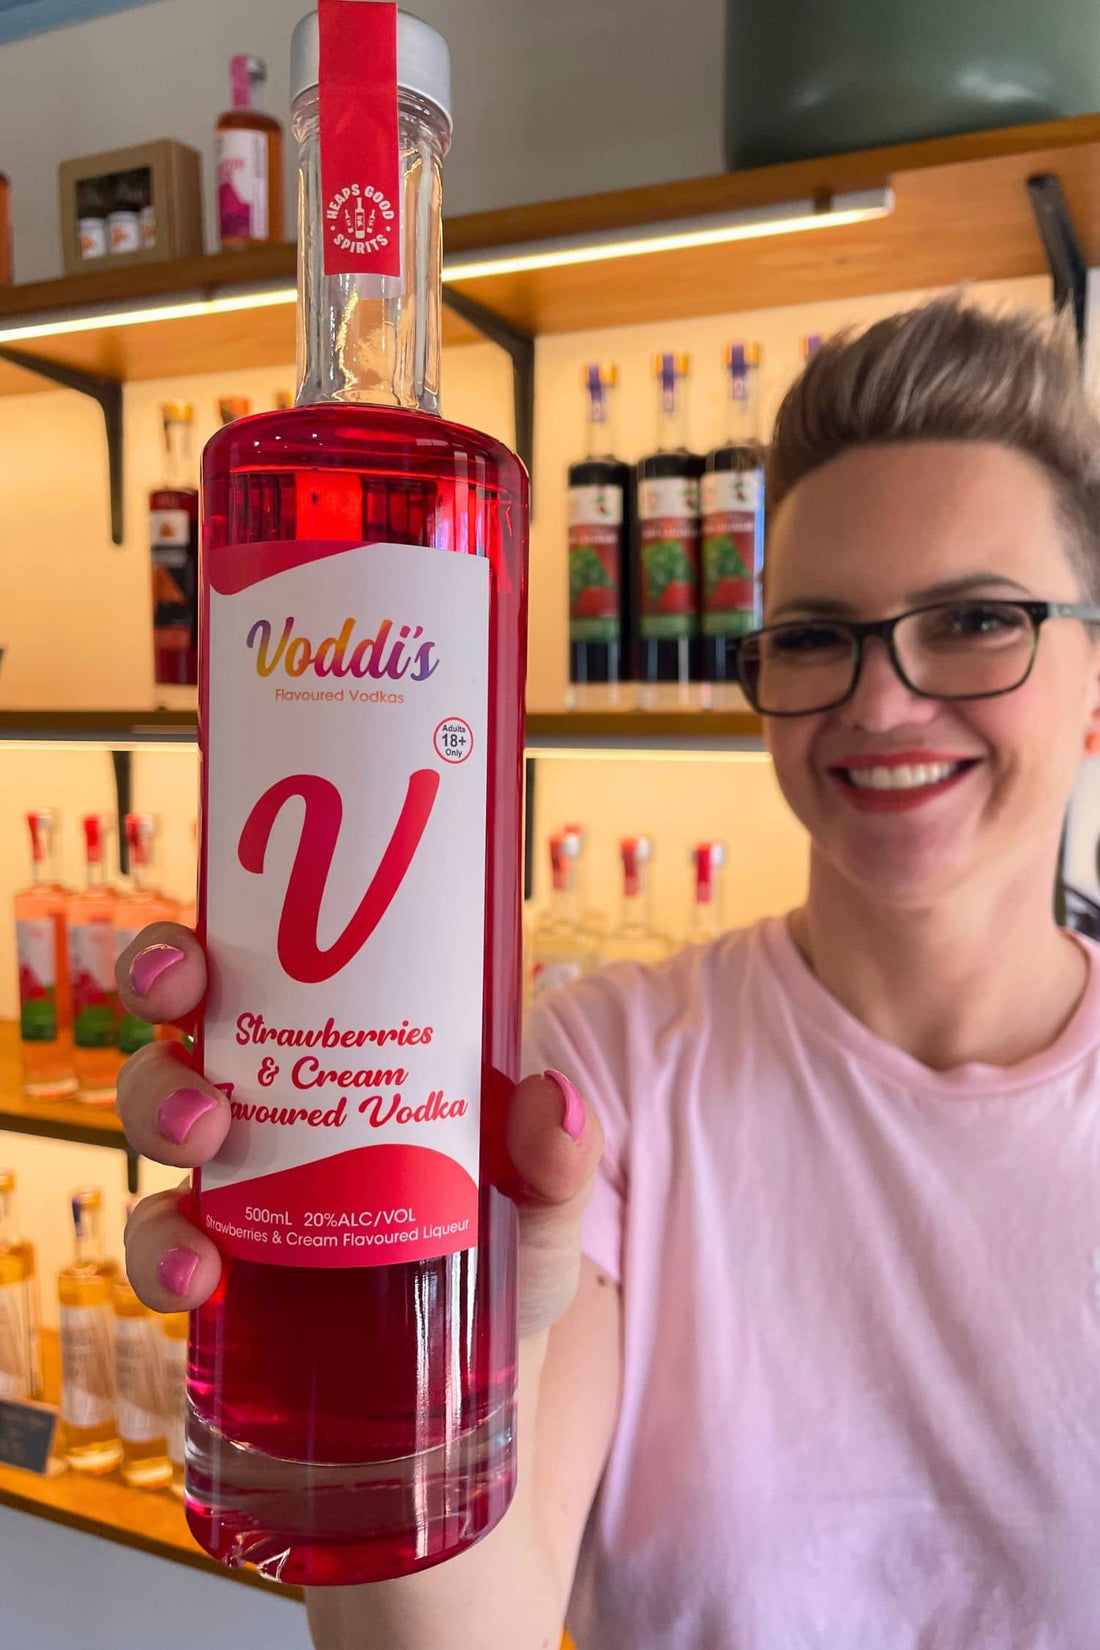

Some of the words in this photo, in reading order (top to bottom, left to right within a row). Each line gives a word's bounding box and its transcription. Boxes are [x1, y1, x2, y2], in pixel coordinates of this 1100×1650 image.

[326, 183, 361, 220] HEAPS
[364, 185, 395, 220] GOOD
[333, 233, 389, 255] SPIRITS
[246, 616, 440, 681] Voddi's
[275, 688, 344, 702] Flavoured
[349, 689, 405, 704] Vodkas
[441, 734, 467, 748] 18+
[442, 724, 466, 733] Adults
[445, 748, 463, 758] Only
[236, 1012, 434, 1048] Strawberries
[257, 1056, 280, 1087] &
[291, 1055, 410, 1090] Cream
[358, 1090, 469, 1128] Vodka
[205, 1214, 268, 1243] Strawberries
[272, 1230, 282, 1244] &
[286, 1231, 338, 1248] Cream
[343, 1228, 419, 1248] Flavoured
[423, 1219, 470, 1240] Liqueur
[245, 1206, 293, 1226] 500mL
[303, 1208, 417, 1228] 20%ALC/VOL
